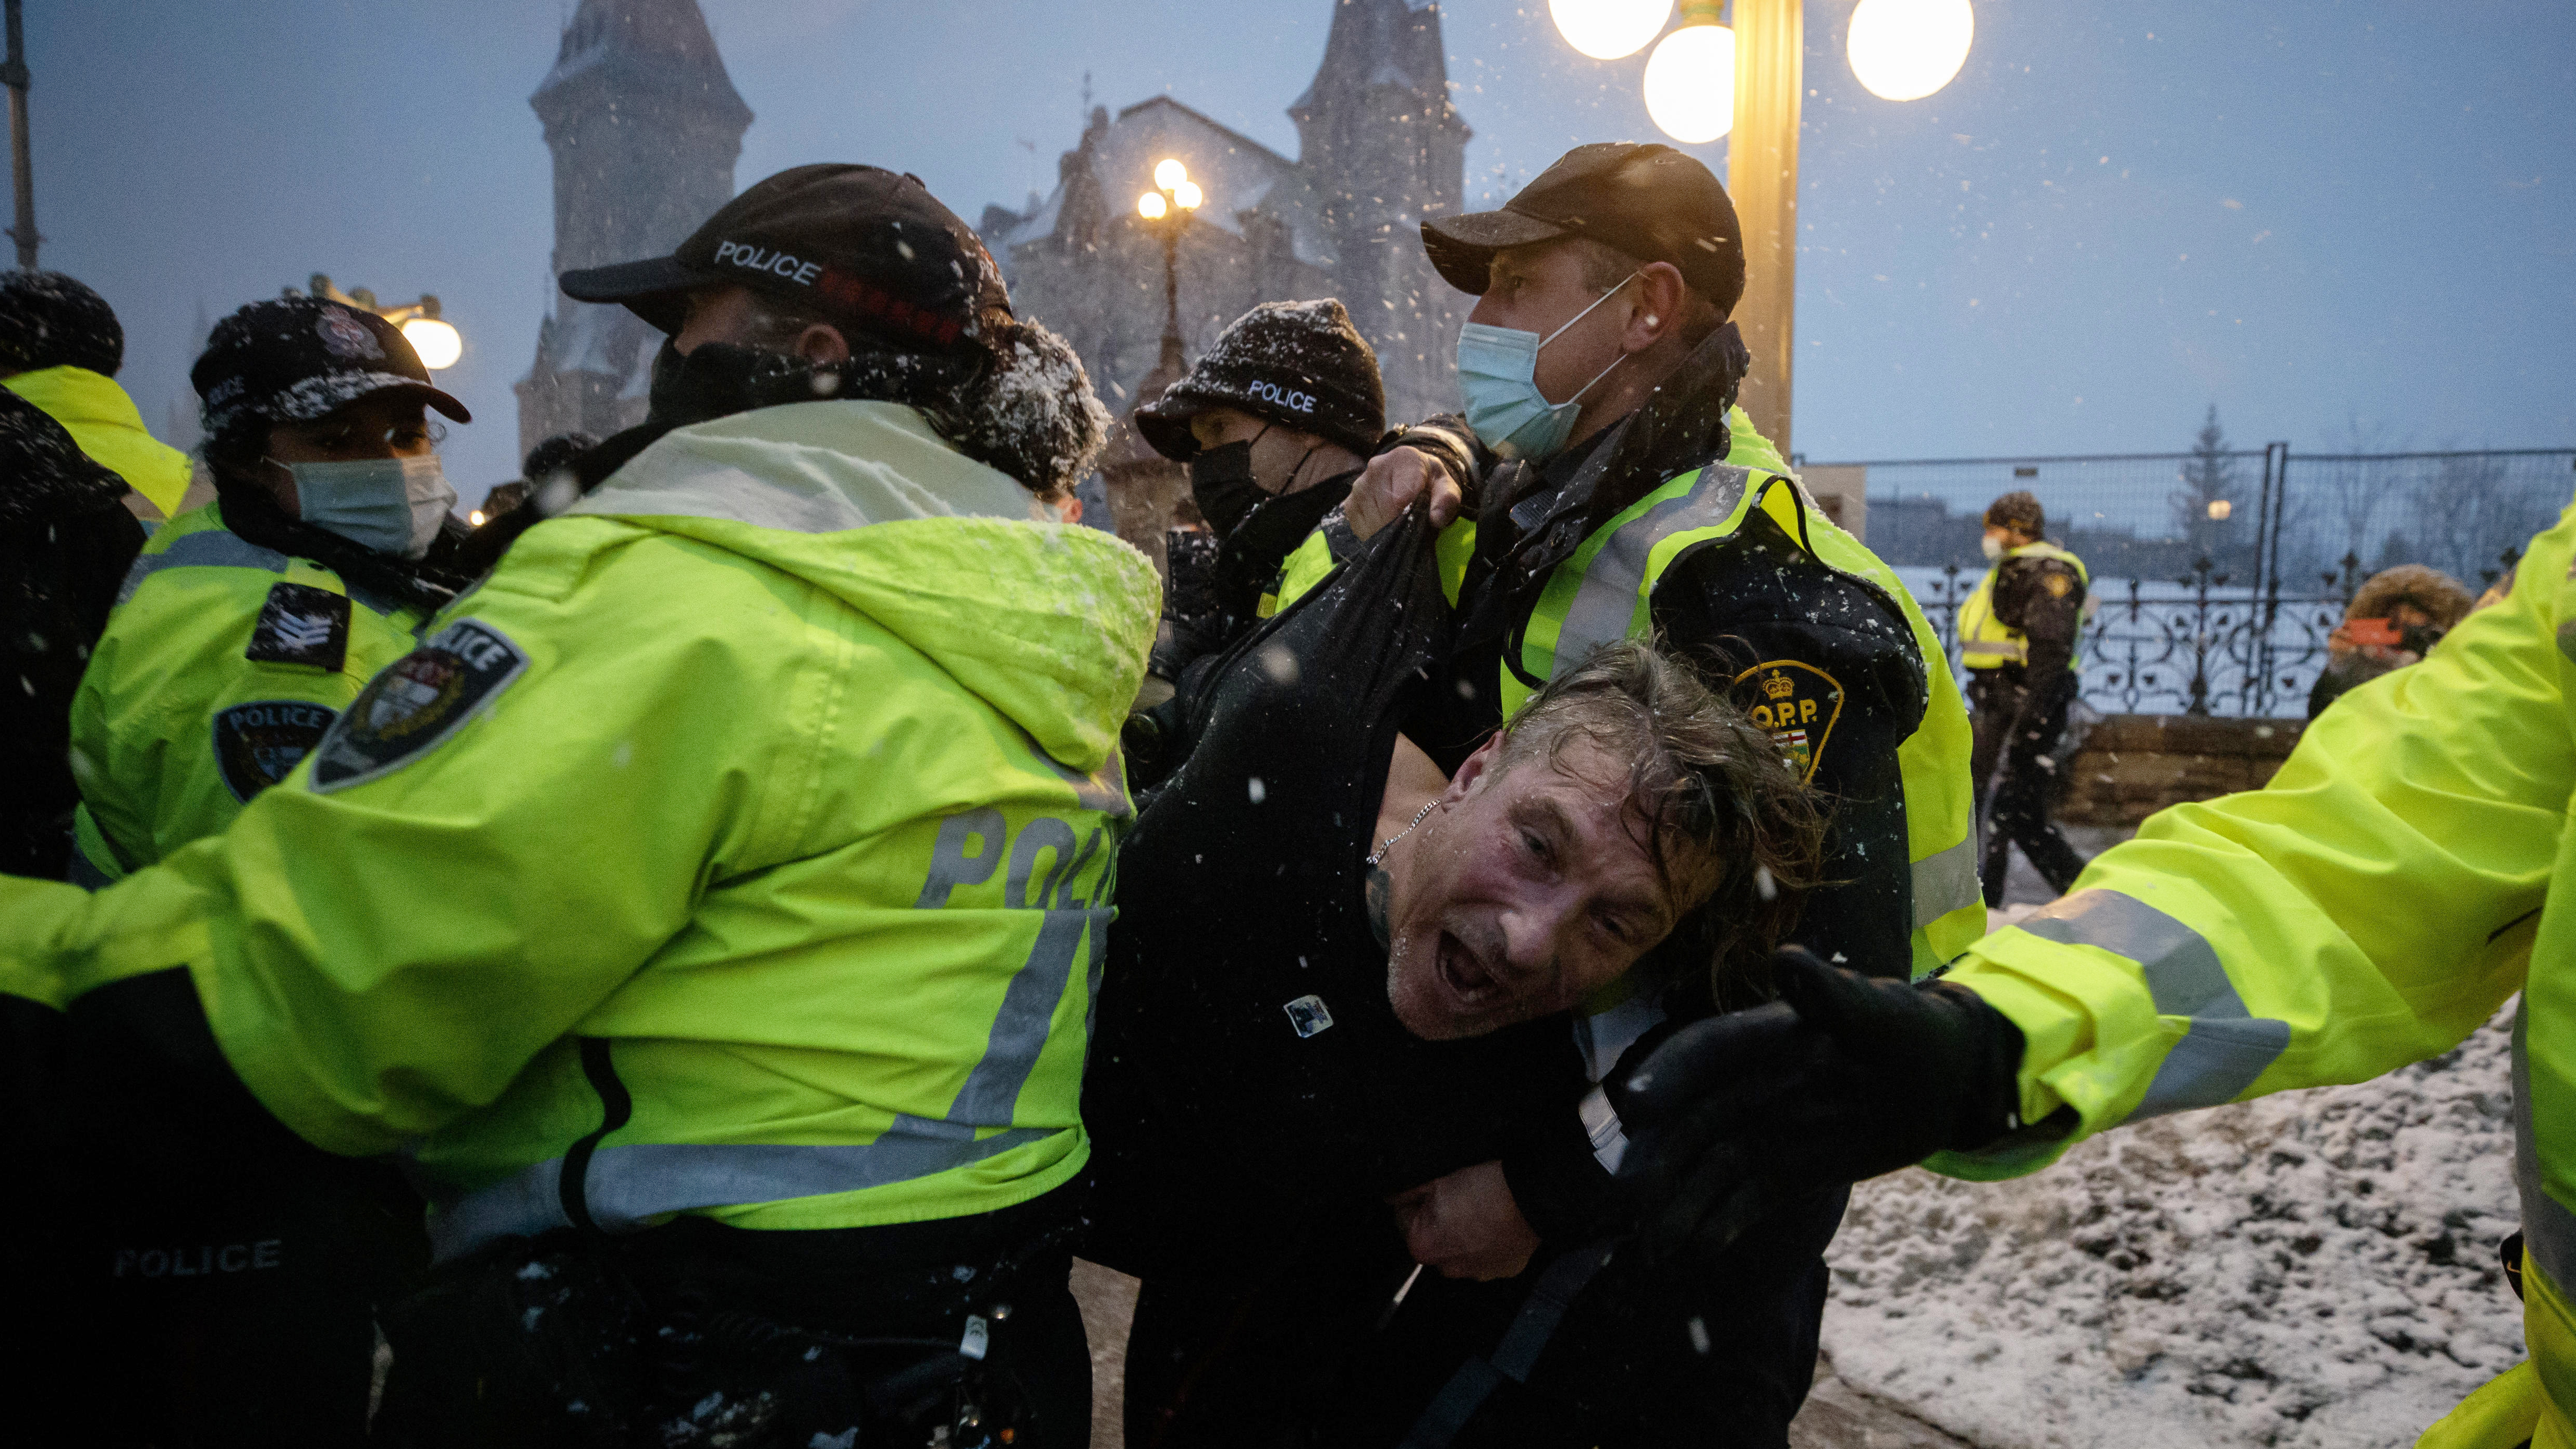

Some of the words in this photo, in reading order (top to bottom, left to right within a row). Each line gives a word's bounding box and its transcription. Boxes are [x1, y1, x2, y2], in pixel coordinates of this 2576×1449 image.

[714, 240, 822, 286] POLICE
[1246, 380, 1317, 413] POLICE
[228, 707, 325, 732] POLICE
[1751, 699, 1817, 730] O.P.P.
[112, 1239, 282, 1278] POLICE
